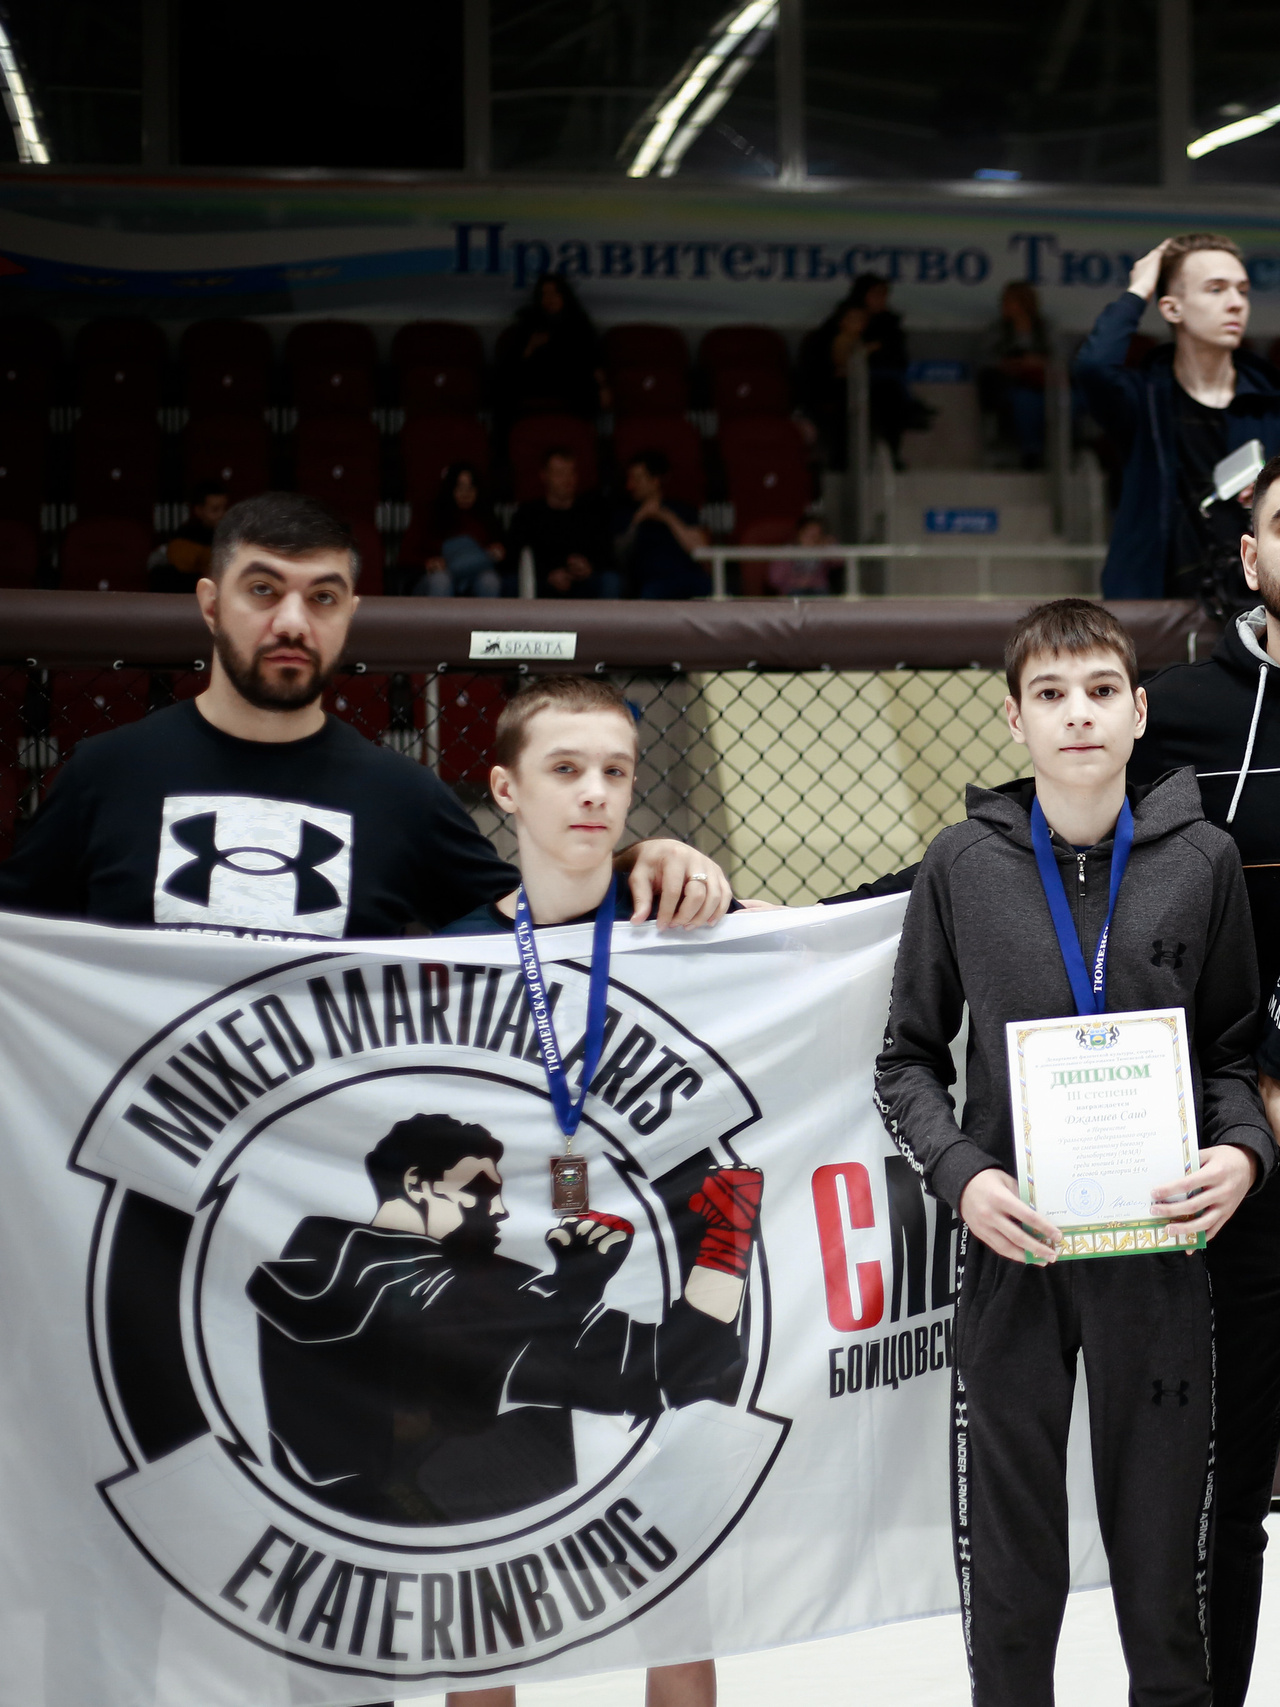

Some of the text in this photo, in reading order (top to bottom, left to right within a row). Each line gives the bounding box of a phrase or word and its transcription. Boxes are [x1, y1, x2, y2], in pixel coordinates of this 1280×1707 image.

[451, 221, 991, 288] Правительство
[504, 641, 563, 655] SPARTA
[517, 921, 561, 1074] ТЮМЕНСКАЯ ОБЛАСТЬ
[122, 994, 315, 1168] MIXED
[306, 962, 565, 1068] MARTIAL
[1050, 1063, 1152, 1090] ДИПЛОМ
[1067, 1088, 1138, 1101] III степени
[1076, 1101, 1130, 1111] награждается
[1064, 1108, 1147, 1125] Джамиев Саид
[1057, 1131, 1157, 1145] Уральского Федерального округа
[1080, 1142, 1119, 1151] смешанному
[1073, 1161, 1090, 1171] среди
[1091, 1159, 1115, 1168] юношей
[957, 1432, 968, 1527] UNDER ARMOUR
[1198, 1471, 1215, 1562] UNDER ARMOUR
[219, 1497, 678, 1662] EKATERINBURG
[960, 1566, 971, 1603] UNDER
